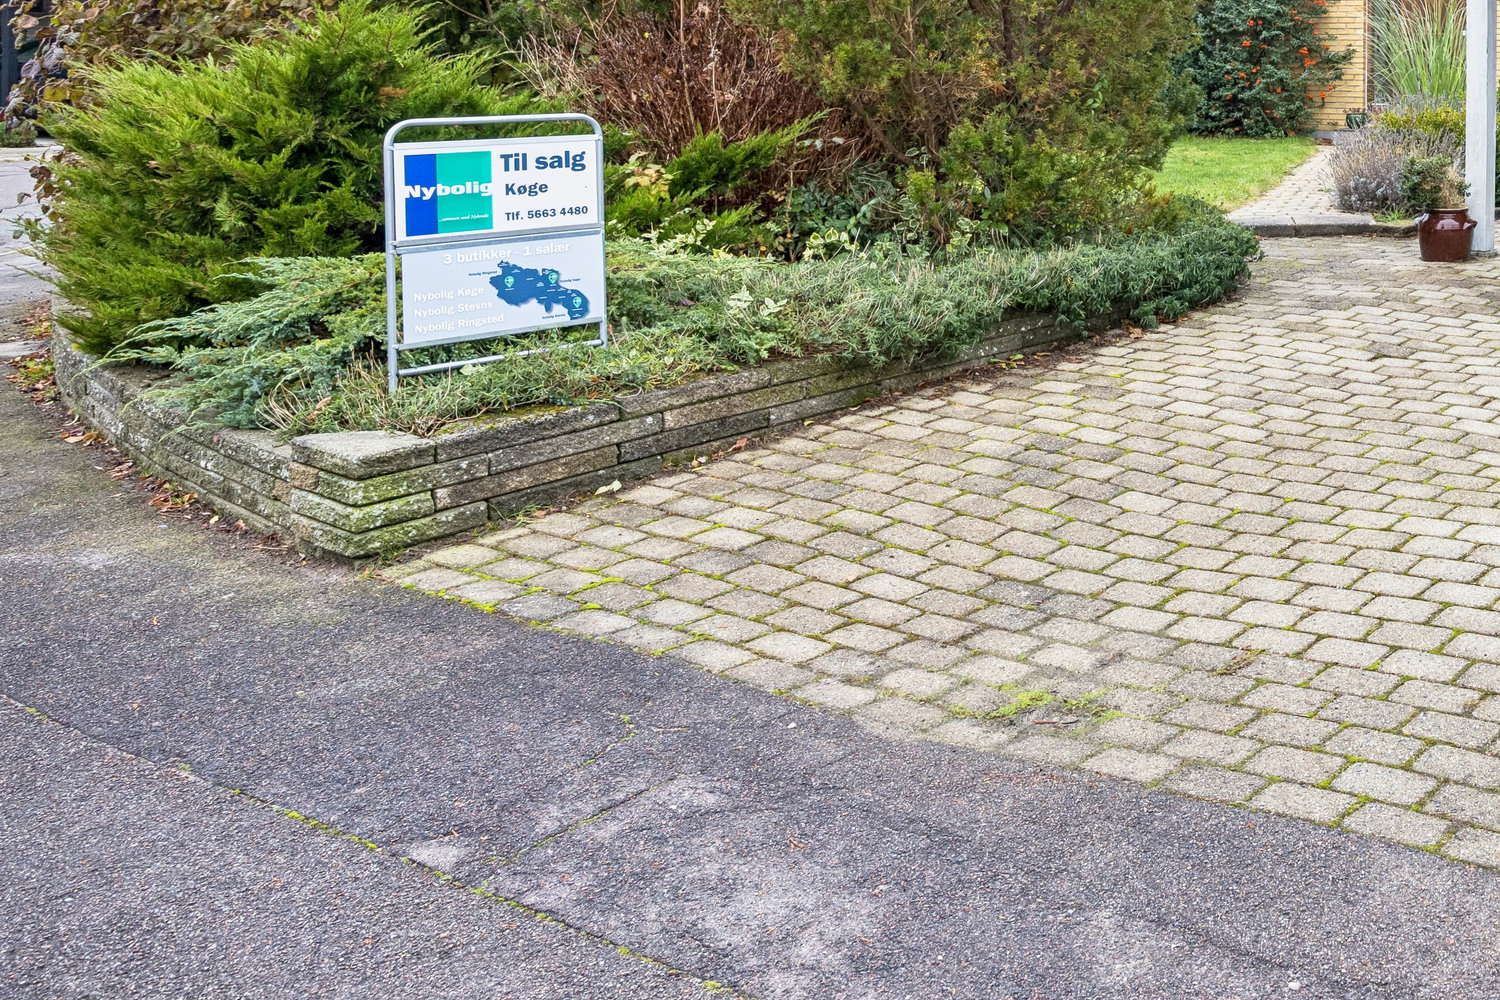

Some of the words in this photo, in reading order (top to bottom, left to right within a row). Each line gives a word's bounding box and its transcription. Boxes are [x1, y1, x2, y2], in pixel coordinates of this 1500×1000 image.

[500, 153, 527, 172] Til
[535, 151, 586, 172] salg
[403, 181, 493, 200] Nybolig
[505, 182, 548, 197] Køge
[505, 211, 524, 221] Tlf.
[527, 208, 557, 219] 5663
[559, 205, 588, 216] 4480
[443, 253, 453, 265] 3
[456, 249, 512, 263] butikker
[523, 245, 532, 256] 1
[535, 243, 570, 255] salær
[413, 289, 455, 303] Nybolig
[457, 287, 484, 297] Køge
[414, 305, 455, 319] Nybolig
[457, 301, 494, 313] Stevns
[414, 321, 456, 335] Nybolig
[458, 313, 505, 328] Ringsted
